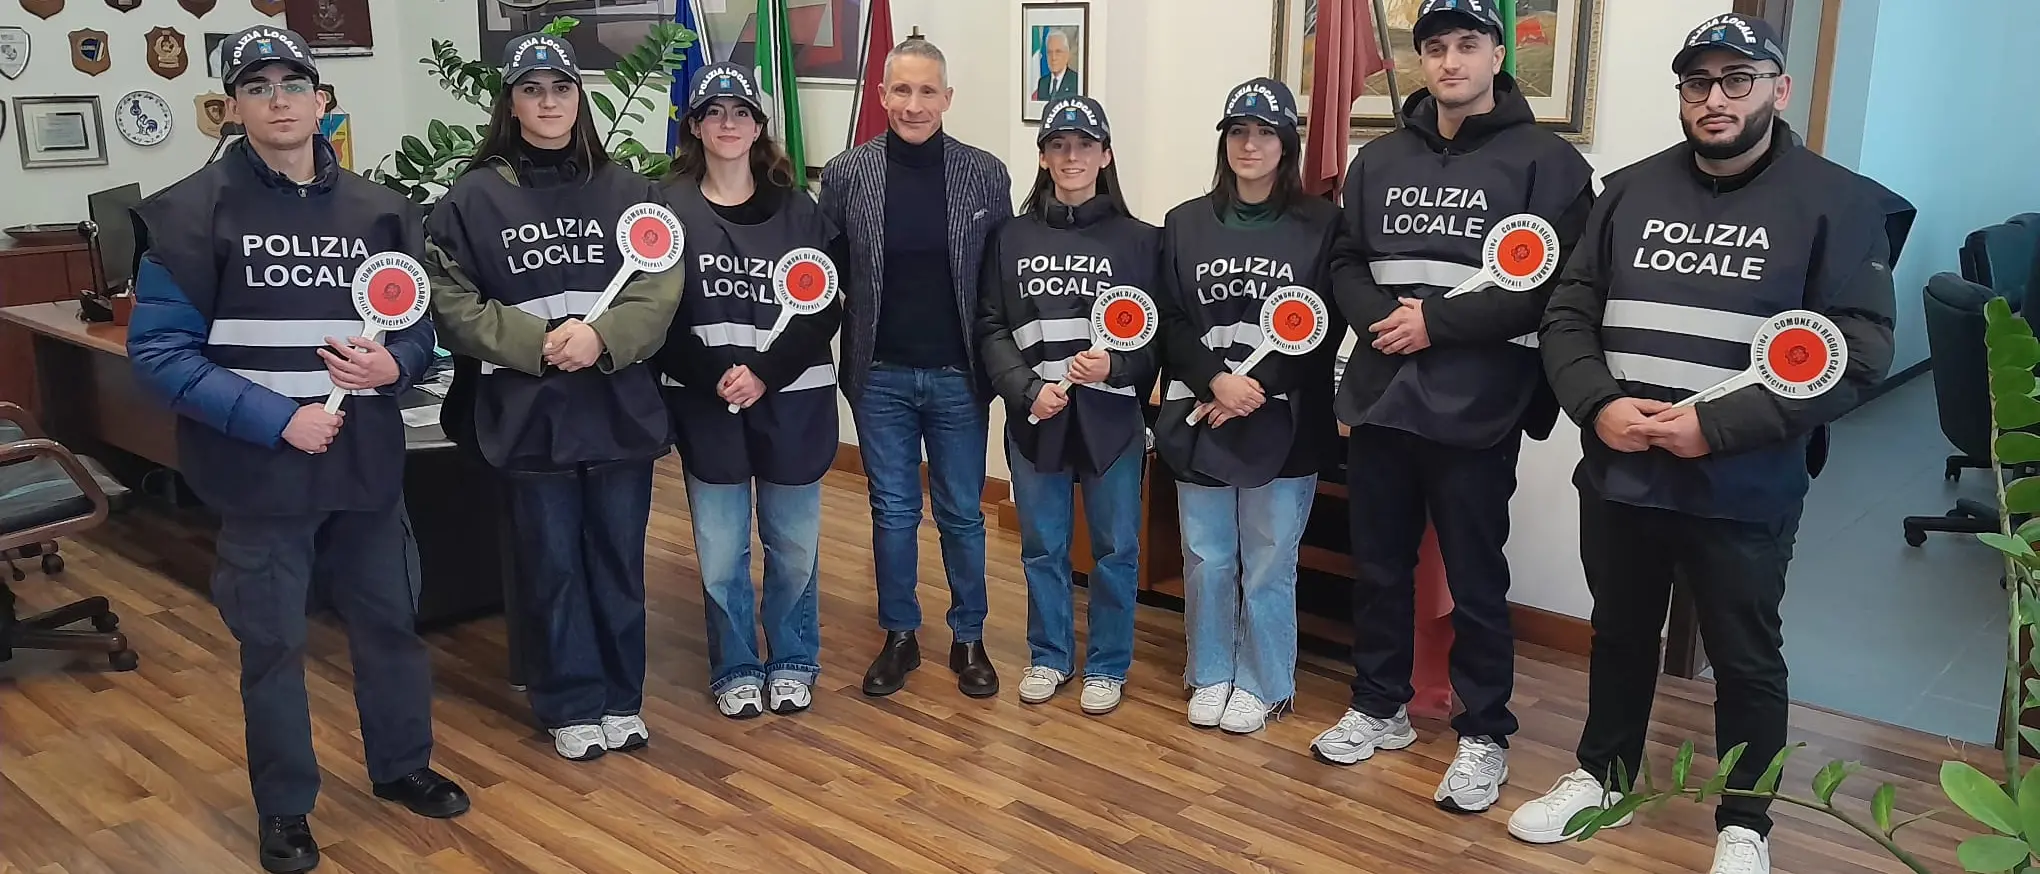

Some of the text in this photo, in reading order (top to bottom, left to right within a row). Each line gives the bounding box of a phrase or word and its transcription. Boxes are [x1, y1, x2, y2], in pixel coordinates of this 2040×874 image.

[1720, 16, 1756, 44] LOCALE
[233, 29, 304, 66] POLIZIA LOCALE
[512, 36, 570, 67] POLIZIA LOCALE
[698, 68, 752, 96] POLIZIA LOCALE
[1044, 98, 1098, 128] POLIZIA LOCALE
[1226, 84, 1280, 114] POLIZIA LOCALE
[1385, 186, 1488, 211] POLIZIA
[501, 218, 604, 248] POLIZIA
[1382, 214, 1485, 238] LOCALE
[1642, 219, 1770, 250] POLIZIA
[242, 234, 369, 258] POLIZIA
[508, 244, 605, 274] LOCALE
[1501, 221, 1554, 284] COMUNE DI REGGIO CALABRIA
[246, 264, 354, 287] LOCAL
[700, 254, 774, 278] POLIZI
[1017, 255, 1113, 277] POLIZIA
[1196, 257, 1294, 282] POLIZIA
[1488, 238, 1521, 287] POLIZIA MUNICIPALE
[1633, 247, 1766, 280] LOCALE
[360, 258, 426, 311] COMUNE DI REGGIO CALABRIA
[702, 278, 780, 305] LOCAL
[1198, 279, 1280, 304] LOCAL
[358, 292, 410, 326] POLIZIA MUNICIPALE
[1756, 334, 1796, 394] POLIZIA MUNICIPALE
[1774, 318, 1839, 391] COMUNE DI REGGIO CALABRIA
